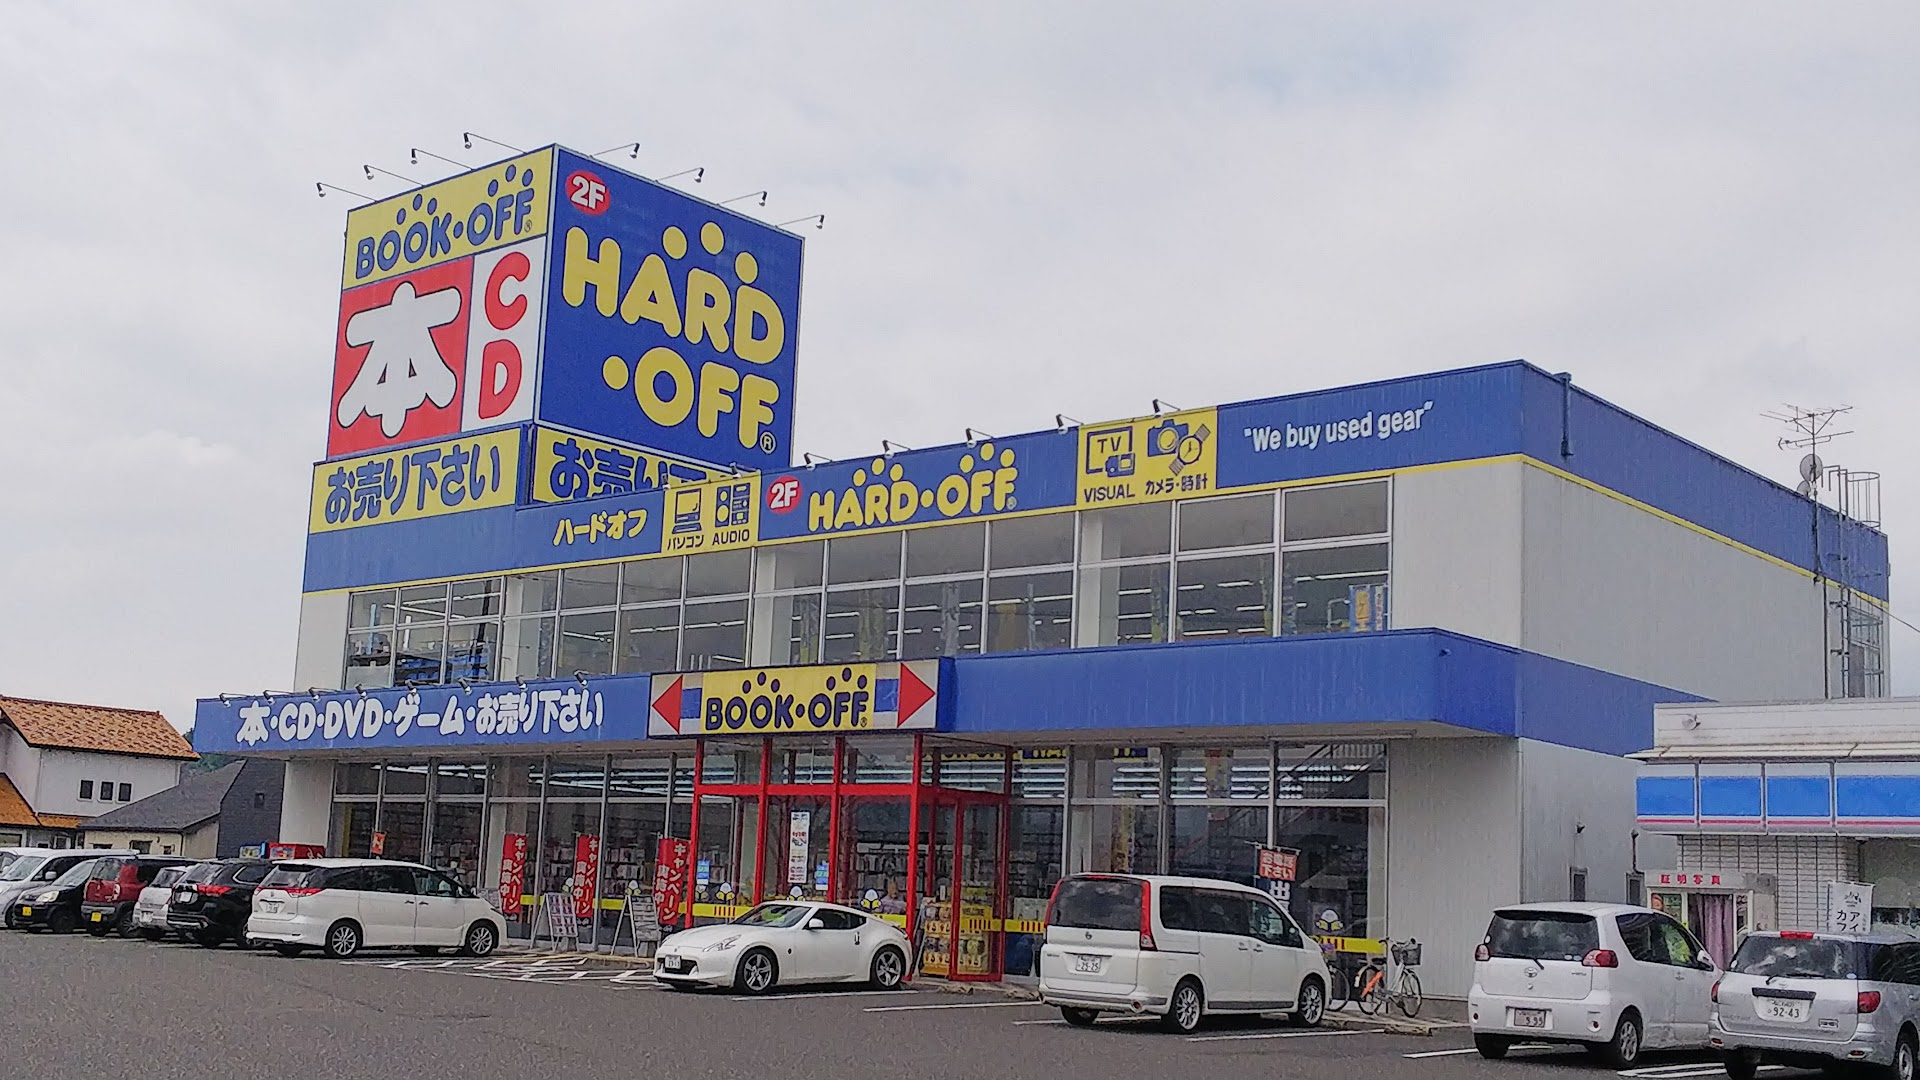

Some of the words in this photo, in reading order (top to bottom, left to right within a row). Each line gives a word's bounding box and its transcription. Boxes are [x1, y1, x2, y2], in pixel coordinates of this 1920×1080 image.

[571, 175, 606, 210] 2F
[562, 226, 785, 365] HARD
[336, 280, 463, 438] 本
[1097, 436, 1122, 454] TV
[1286, 422, 1322, 450] buy
[1325, 410, 1374, 443] used
[325, 443, 501, 524] お売り下さい
[770, 481, 800, 509] 2F
[1083, 483, 1136, 503] VISUAL
[1145, 473, 1209, 496] カメラ・時計
[552, 508, 648, 547] ハードオフ
[666, 534, 705, 551] パソコン
[711, 528, 751, 546] AUDIO
[508, 837, 527, 911] キャンペーン
[581, 839, 598, 914] キャンペーン
[663, 842, 686, 920] キャンペーン
[1773, 1006, 1799, 1018] 92-43
